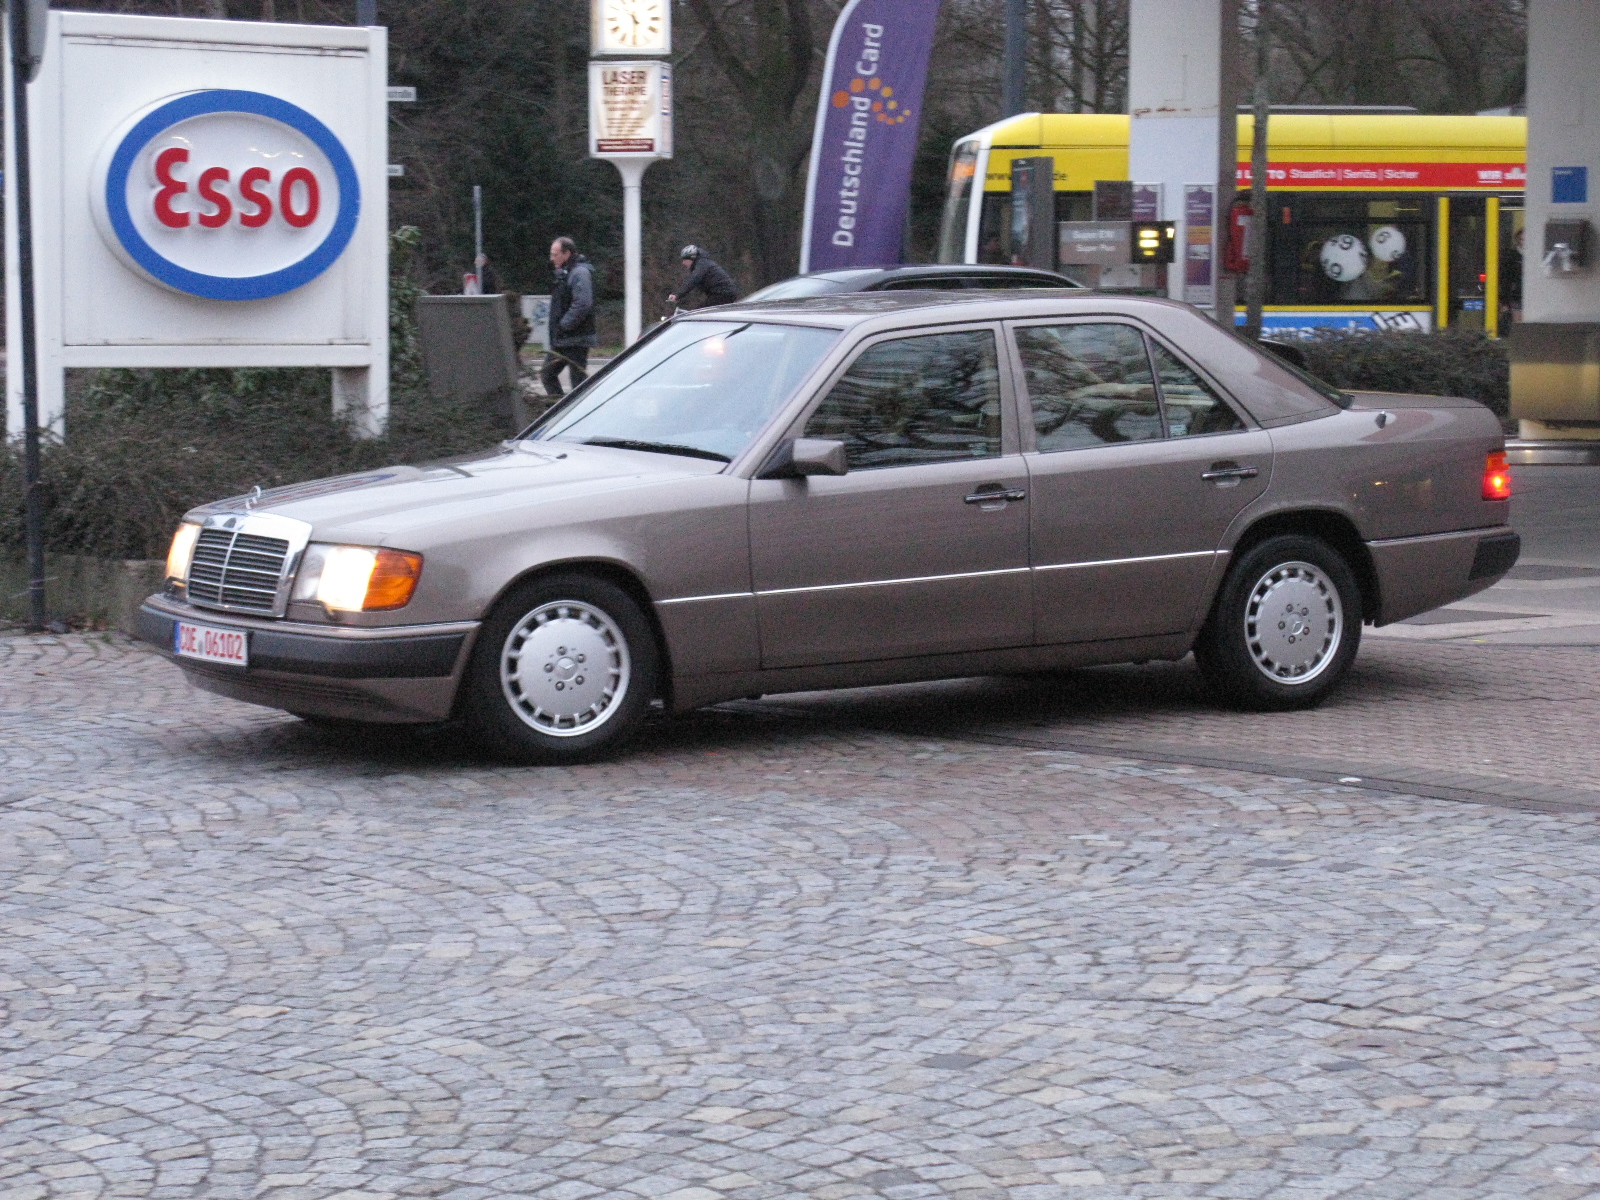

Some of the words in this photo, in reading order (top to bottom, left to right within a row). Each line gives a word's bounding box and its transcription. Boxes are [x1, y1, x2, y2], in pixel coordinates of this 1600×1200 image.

[602, 71, 647, 85] LASER
[831, 96, 872, 247] Deutschland
[205, 630, 243, 660] 06102
